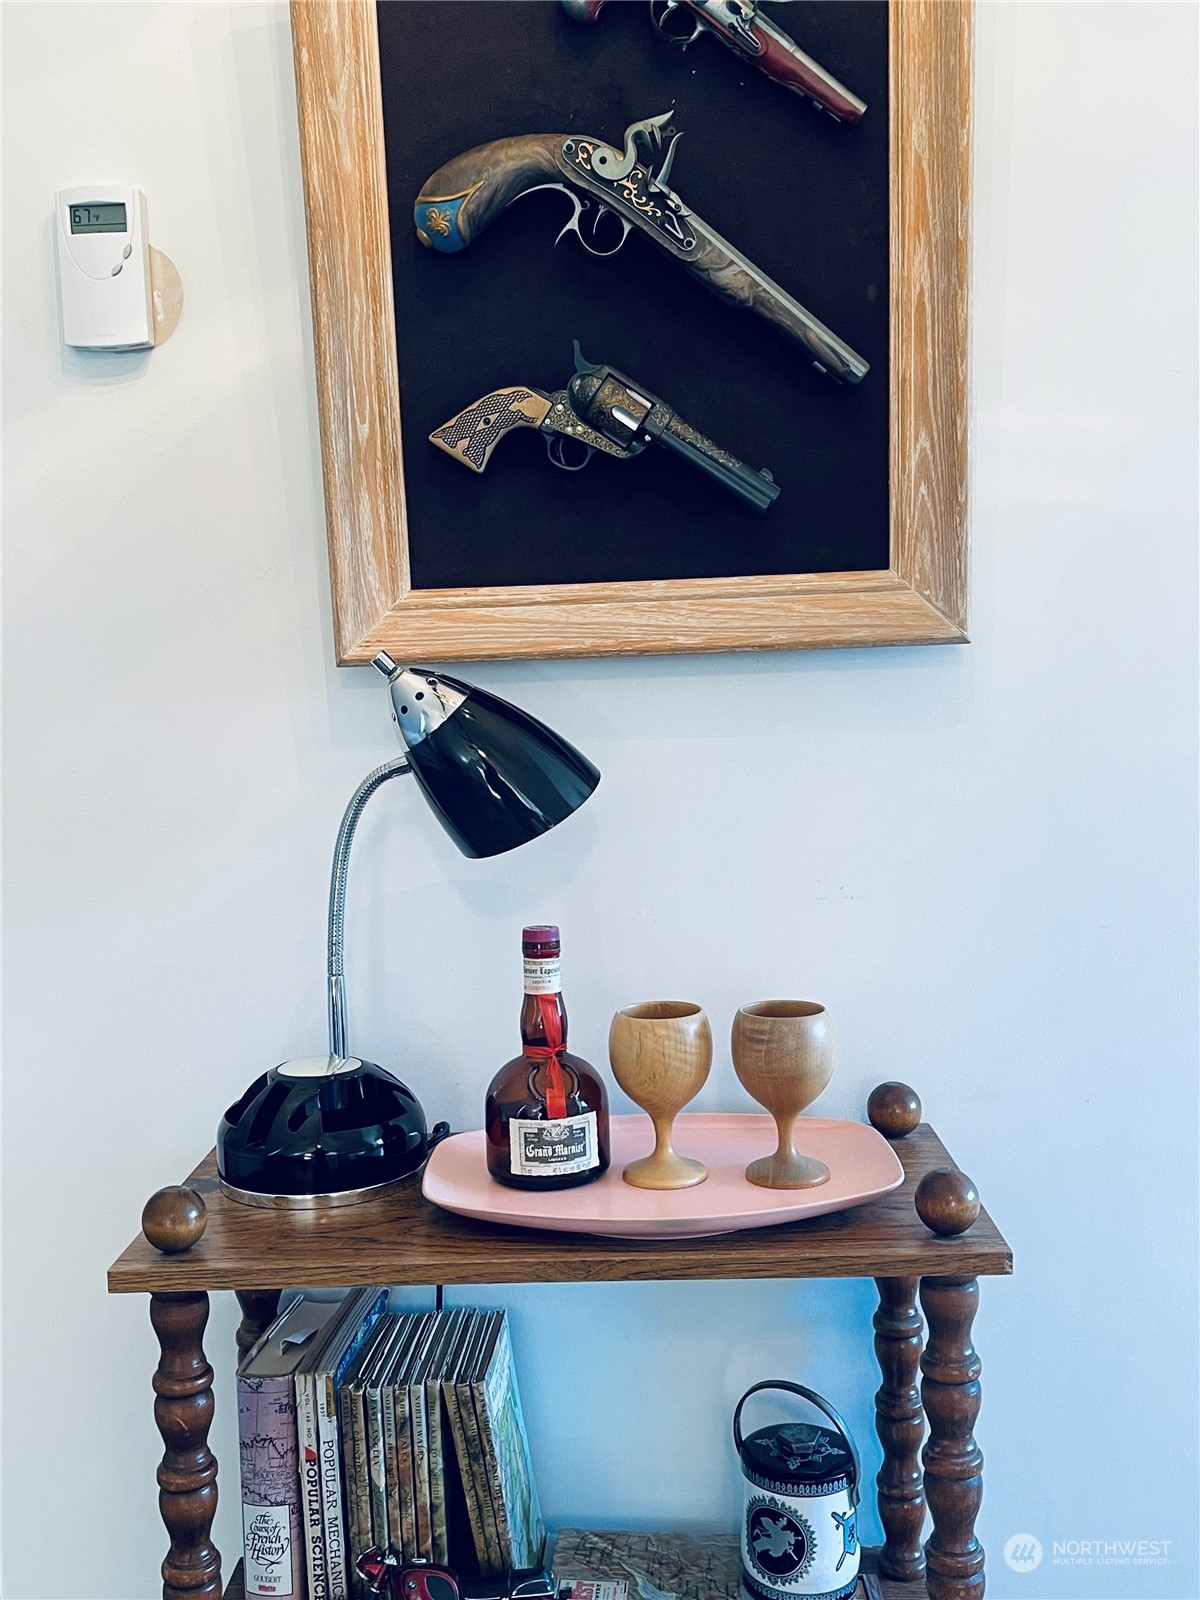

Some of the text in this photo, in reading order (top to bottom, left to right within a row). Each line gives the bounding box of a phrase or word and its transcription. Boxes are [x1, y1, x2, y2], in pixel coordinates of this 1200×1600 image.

[73, 208, 91, 224] 67
[526, 1142, 584, 1158] Grand Marnier
[385, 1393, 393, 1439] NORTHERN
[450, 1394, 464, 1443] CHILTERNS
[461, 1448, 468, 1459] TO
[371, 1430, 379, 1466] ANGLIA
[432, 1448, 438, 1458] TO
[305, 1457, 320, 1528] POPULAR
[432, 1461, 440, 1501] TYNESIDE
[256, 1511, 274, 1525] The
[323, 1439, 344, 1600] POPULAR MECHANICS
[245, 1525, 286, 1552] French
[251, 1537, 290, 1561] History
[254, 1574, 282, 1584] GOUBERT
